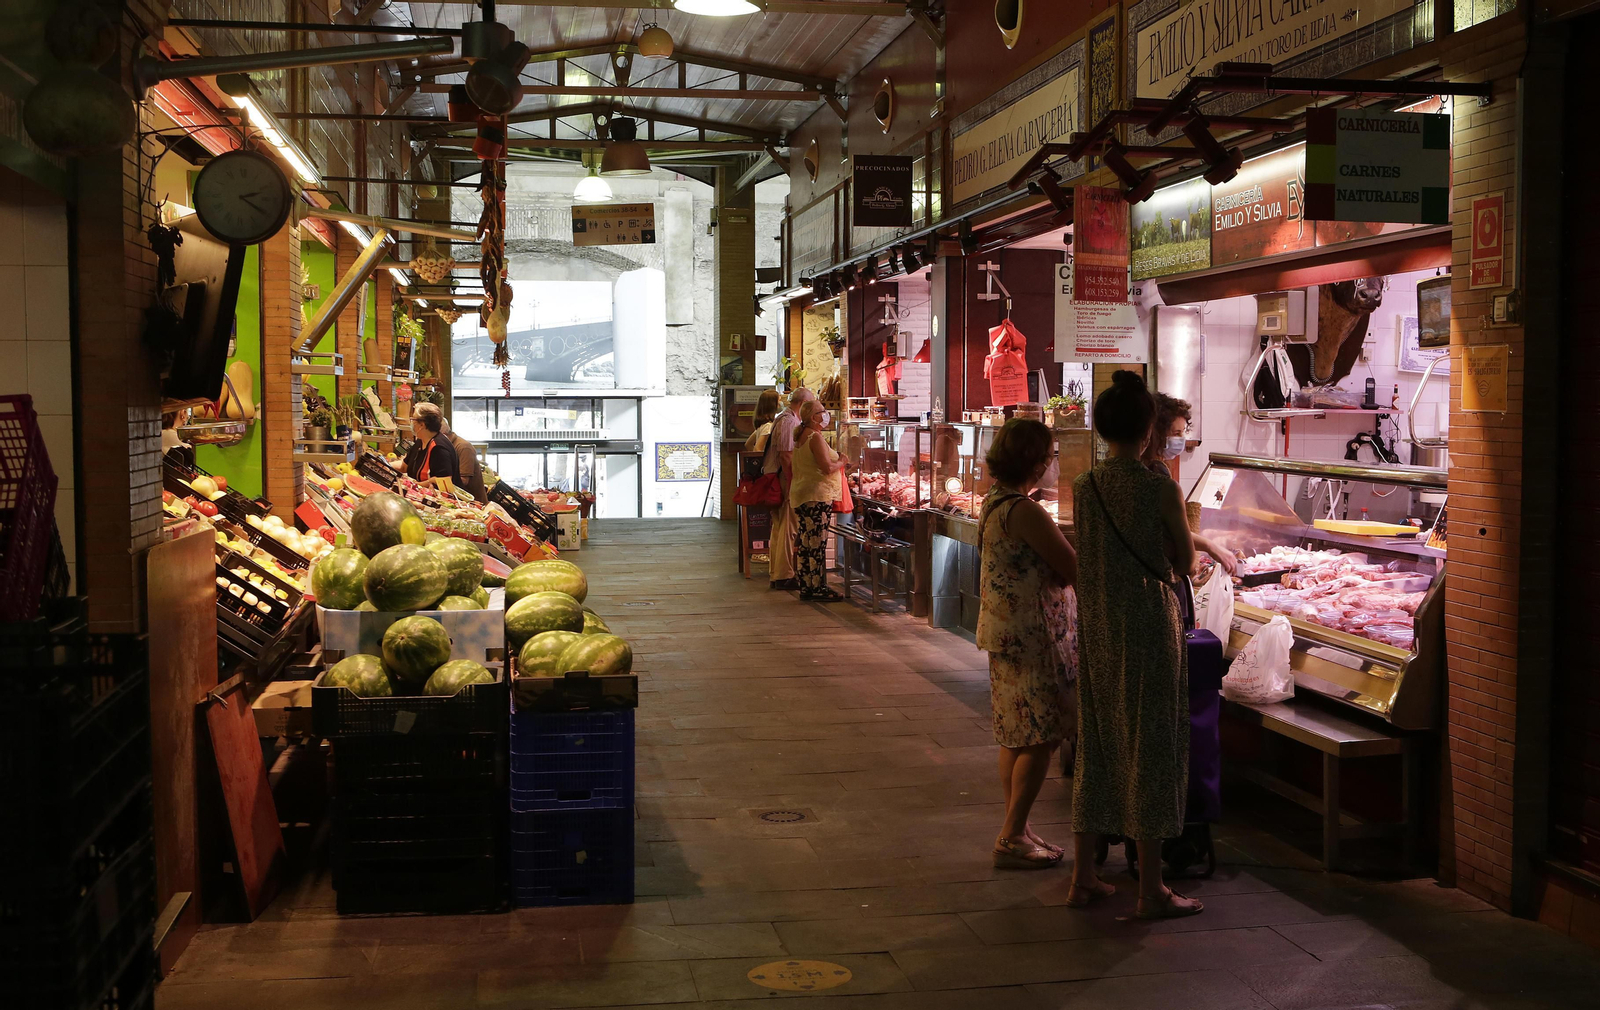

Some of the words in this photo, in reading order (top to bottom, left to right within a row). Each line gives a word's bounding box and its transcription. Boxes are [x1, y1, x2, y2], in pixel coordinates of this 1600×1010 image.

[1149, 12, 1195, 85] EMILIO
[1198, 3, 1209, 59] Y
[1265, 32, 1291, 60] TORO
[1294, 25, 1307, 48] DE
[1310, 13, 1337, 42] LIDIA
[1337, 116, 1421, 134] CARNICERÍA
[954, 150, 978, 186] PEDRO
[988, 131, 1014, 171] ELENA
[1016, 95, 1074, 156] CARNICERÍA
[1339, 164, 1401, 178] CARNES
[1215, 184, 1264, 212] CARNICERÍA
[1336, 188, 1420, 204] NATURALES
[1214, 207, 1245, 231] EMILIO
[1245, 208, 1252, 224] Y
[1253, 201, 1282, 221] SILVIA
[1134, 259, 1152, 272] RESES
[1475, 260, 1499, 271] PULSADOR
[1478, 276, 1496, 284] ALARMA
[1084, 287, 1120, 298] 608.153.259
